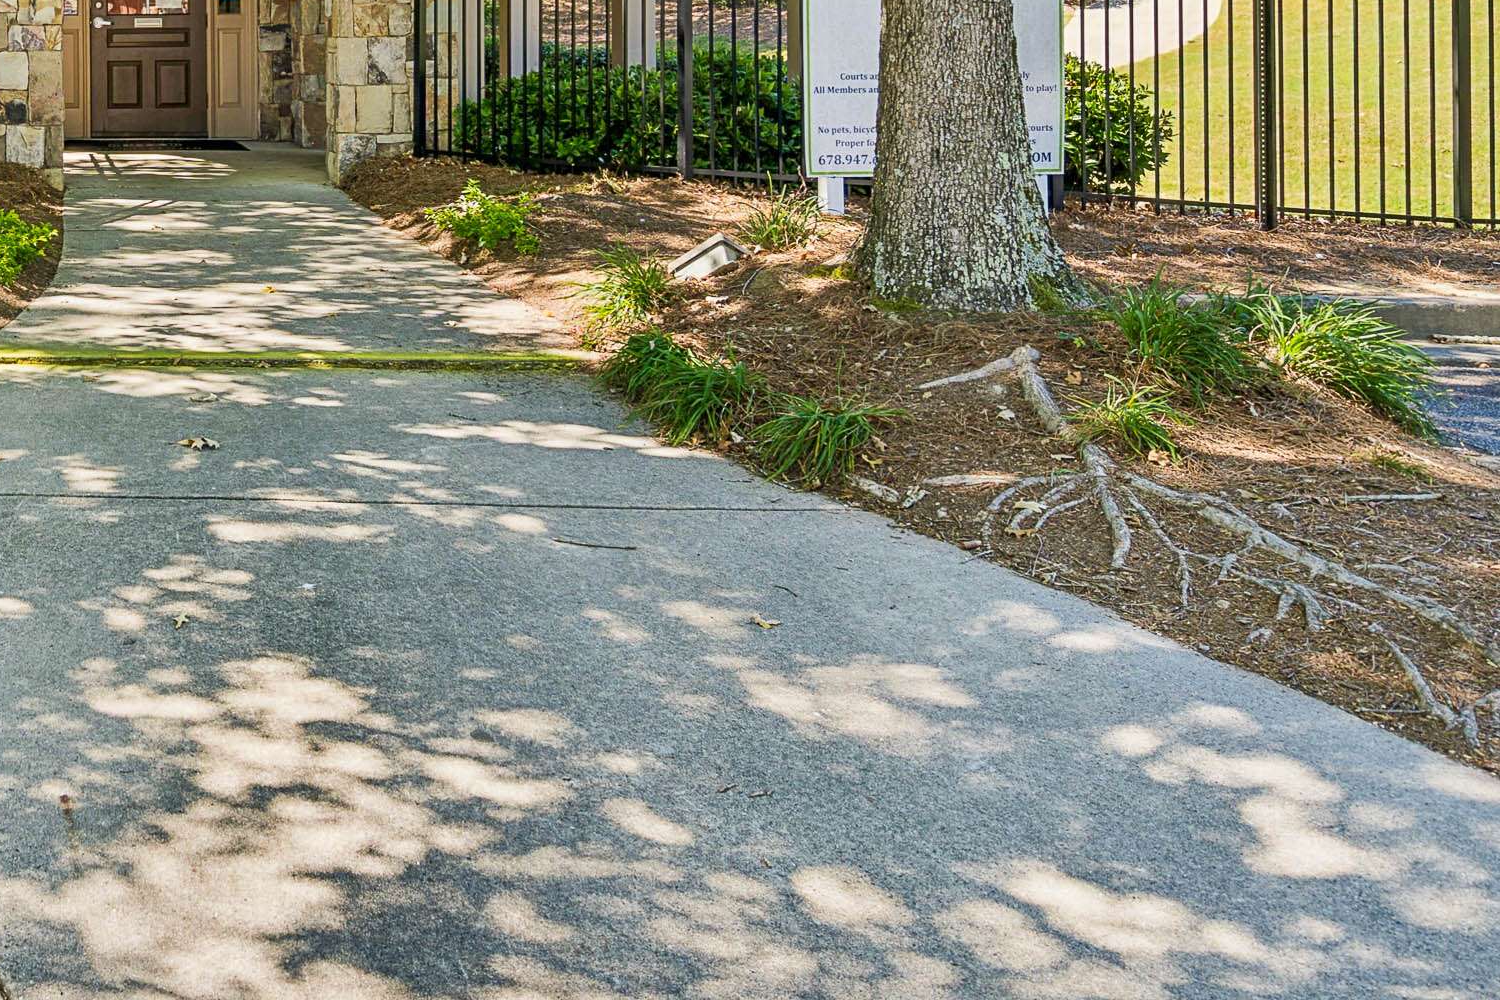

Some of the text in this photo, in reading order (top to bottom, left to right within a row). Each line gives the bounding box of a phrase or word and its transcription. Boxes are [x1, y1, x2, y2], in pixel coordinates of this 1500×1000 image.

[813, 86, 826, 95] All
[827, 86, 867, 95] Members
[1036, 83, 1058, 94] play!
[817, 125, 877, 136] No pets, bicyc
[835, 139, 866, 149] Proper
[818, 155, 878, 165] 678.947.6
